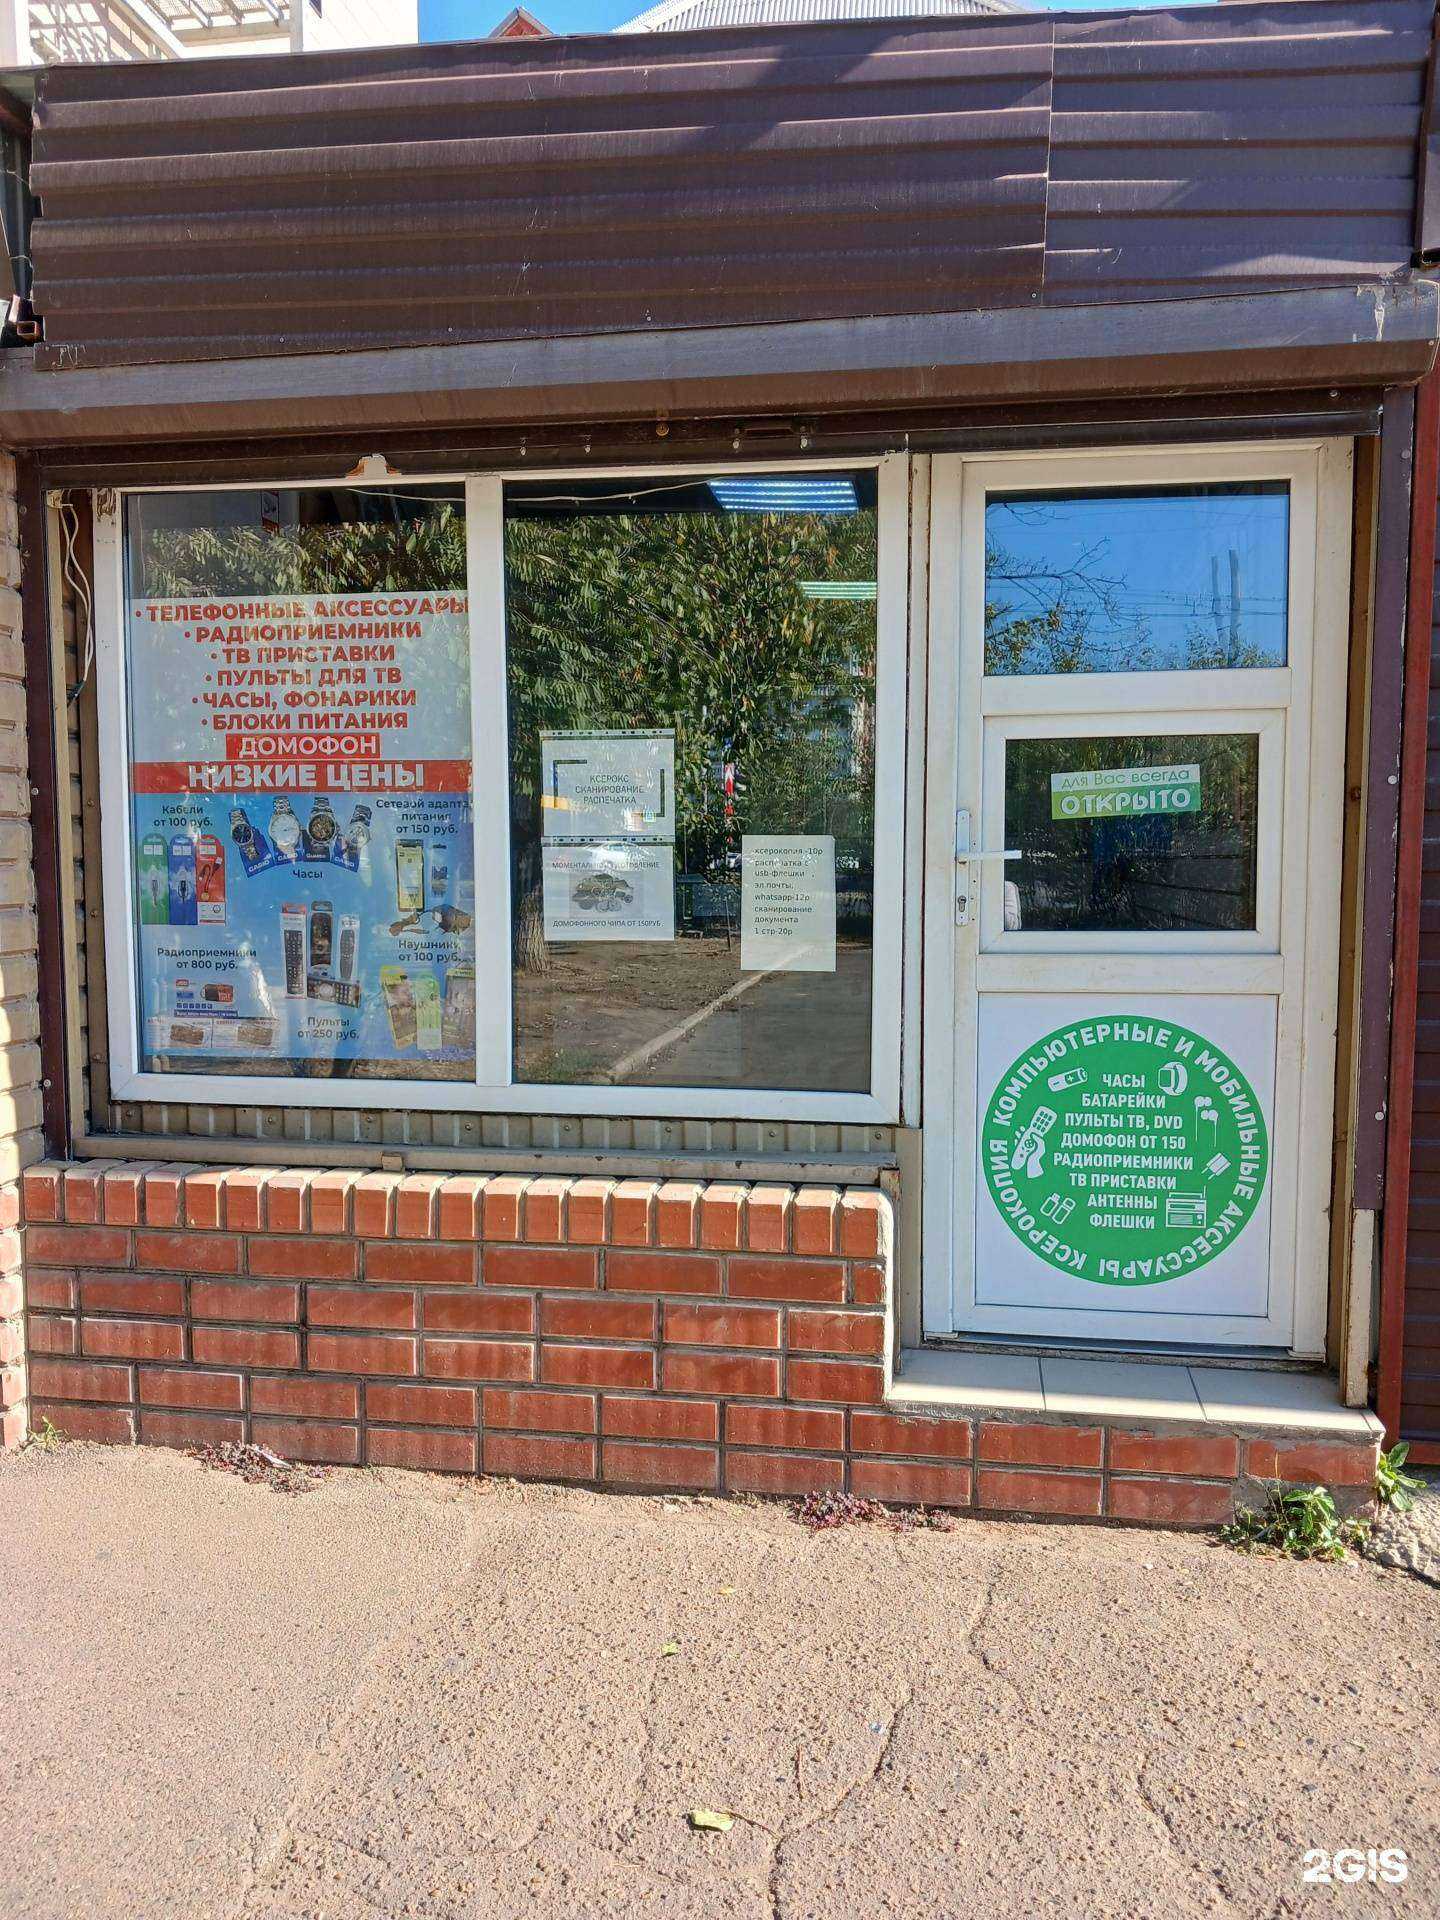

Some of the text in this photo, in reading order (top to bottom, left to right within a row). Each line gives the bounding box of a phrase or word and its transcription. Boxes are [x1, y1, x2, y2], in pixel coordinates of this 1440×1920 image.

[146, 595, 468, 622] ТЕЛЕФОННЫЕ АКСЕССУАРЫ
[195, 620, 422, 643] РАДИОПРИЕМНИКИ
[222, 645, 395, 664] ТВ ПРИСТАВКИ
[217, 667, 402, 687] ПУЛЬТЫ ДЛЯ ТВ
[203, 689, 416, 711] ЧАСЫ, ФОНАРИКИ
[213, 712, 408, 730] БЛОКИ ПИТАНИЯ
[238, 735, 376, 759] ДОМОФОН
[188, 763, 424, 791] НИЗКИЕ ЦЕНЫ
[590, 775, 629, 783] КСЕРОКС
[1061, 769, 1189, 790] для Вас всегда
[575, 785, 645, 794] СКАНИРОВАНИЕ
[583, 796, 637, 804] РАСПЕЧАТКА
[1060, 788, 1190, 815] ОТКРЫТО
[162, 805, 204, 814] Кабели
[154, 818, 213, 829] от 100 руб.
[412, 825, 430, 834] 150
[434, 825, 458, 836] руб.
[292, 869, 323, 879] Часы
[157, 948, 257, 959] Радиоприемники
[398, 940, 460, 951] Наушники
[176, 960, 238, 970] от 800 руб.
[398, 952, 461, 963] от 100 руб.
[308, 1017, 350, 1027] Пульты
[313, 1029, 332, 1038] 250
[336, 1029, 360, 1040] руб.
[1102, 1073, 1145, 1088] ЧАСЫ
[1081, 1091, 1166, 1109] БАТАРЕЙКИ
[1065, 1113, 1183, 1131] ПУЛЬТЫ ТВ, DVD
[1060, 1133, 1186, 1150] ДОМОФОН ОТ 150
[989, 1022, 1262, 1280] КОМПЬЮТЕРНЫЕ И МОБИЛЬНЫЕ АКСЕССУАРЫ КСЕРОКОПИЯ
[1053, 1152, 1193, 1171] РАДИОПРИЕМНИКИ
[1069, 1173, 1177, 1190] ТВ ПРИСТАВКИ
[1087, 1194, 1158, 1210] АНТЕННЫ
[1089, 1214, 1155, 1229] ФЛЕШКИ
